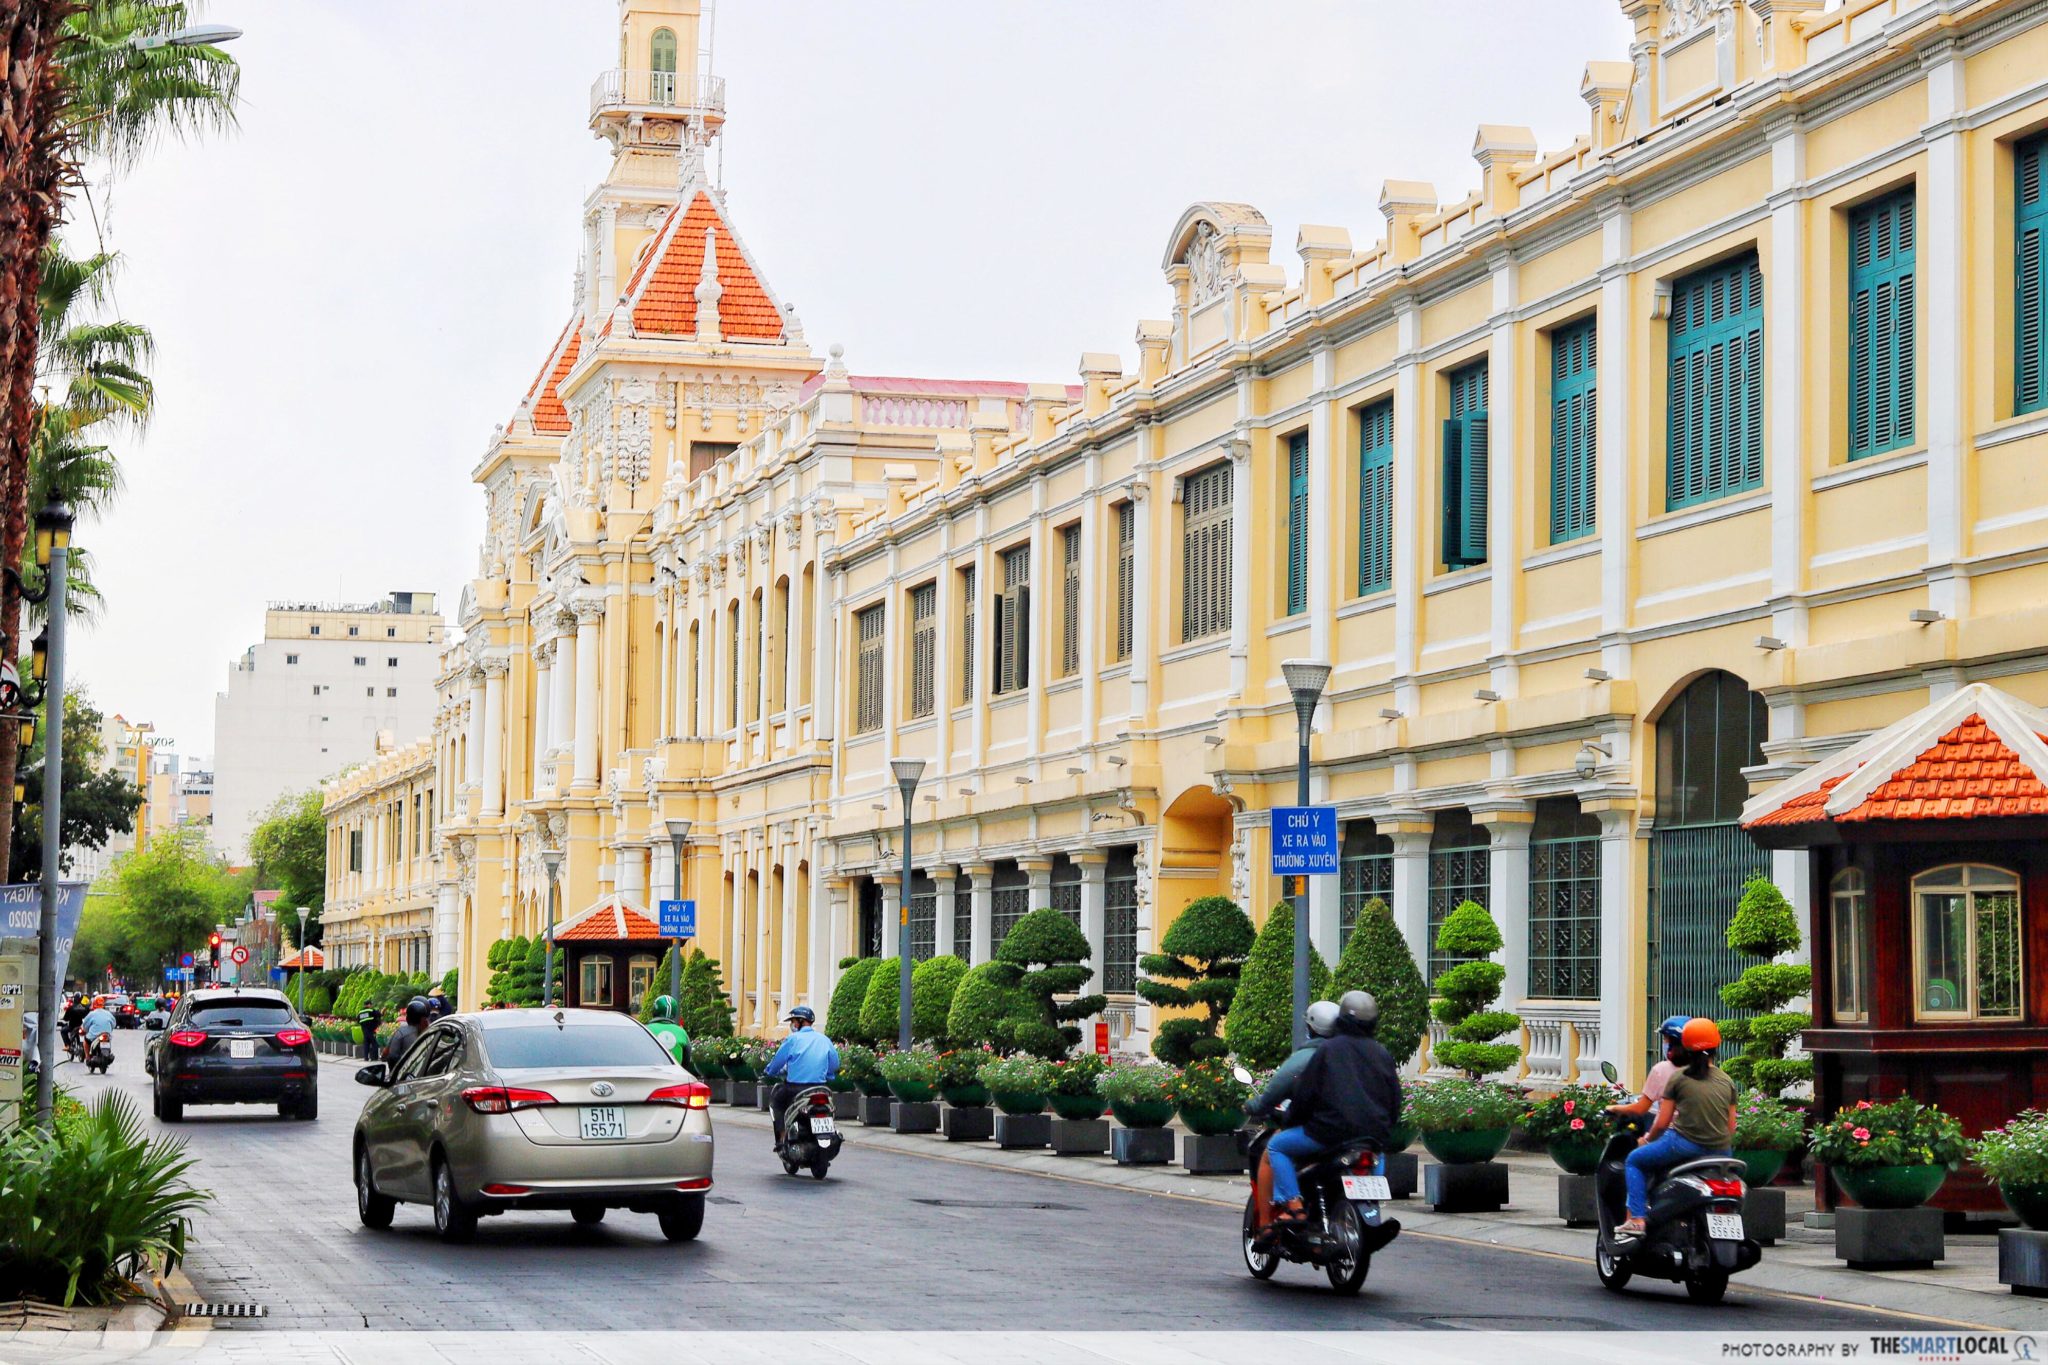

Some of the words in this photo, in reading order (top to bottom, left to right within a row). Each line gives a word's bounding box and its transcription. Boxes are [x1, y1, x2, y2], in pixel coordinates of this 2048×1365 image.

[1288, 811, 1309, 828] CHÚ
[1312, 811, 1320, 828] Ý
[1281, 834, 1293, 847] XE
[1296, 834, 1309, 847] RA
[1311, 831, 1327, 847] VÀO
[667, 902, 680, 912] CHÚ
[682, 902, 687, 912] Ý
[591, 1108, 615, 1122] 51H
[584, 1123, 623, 1137] 155.71
